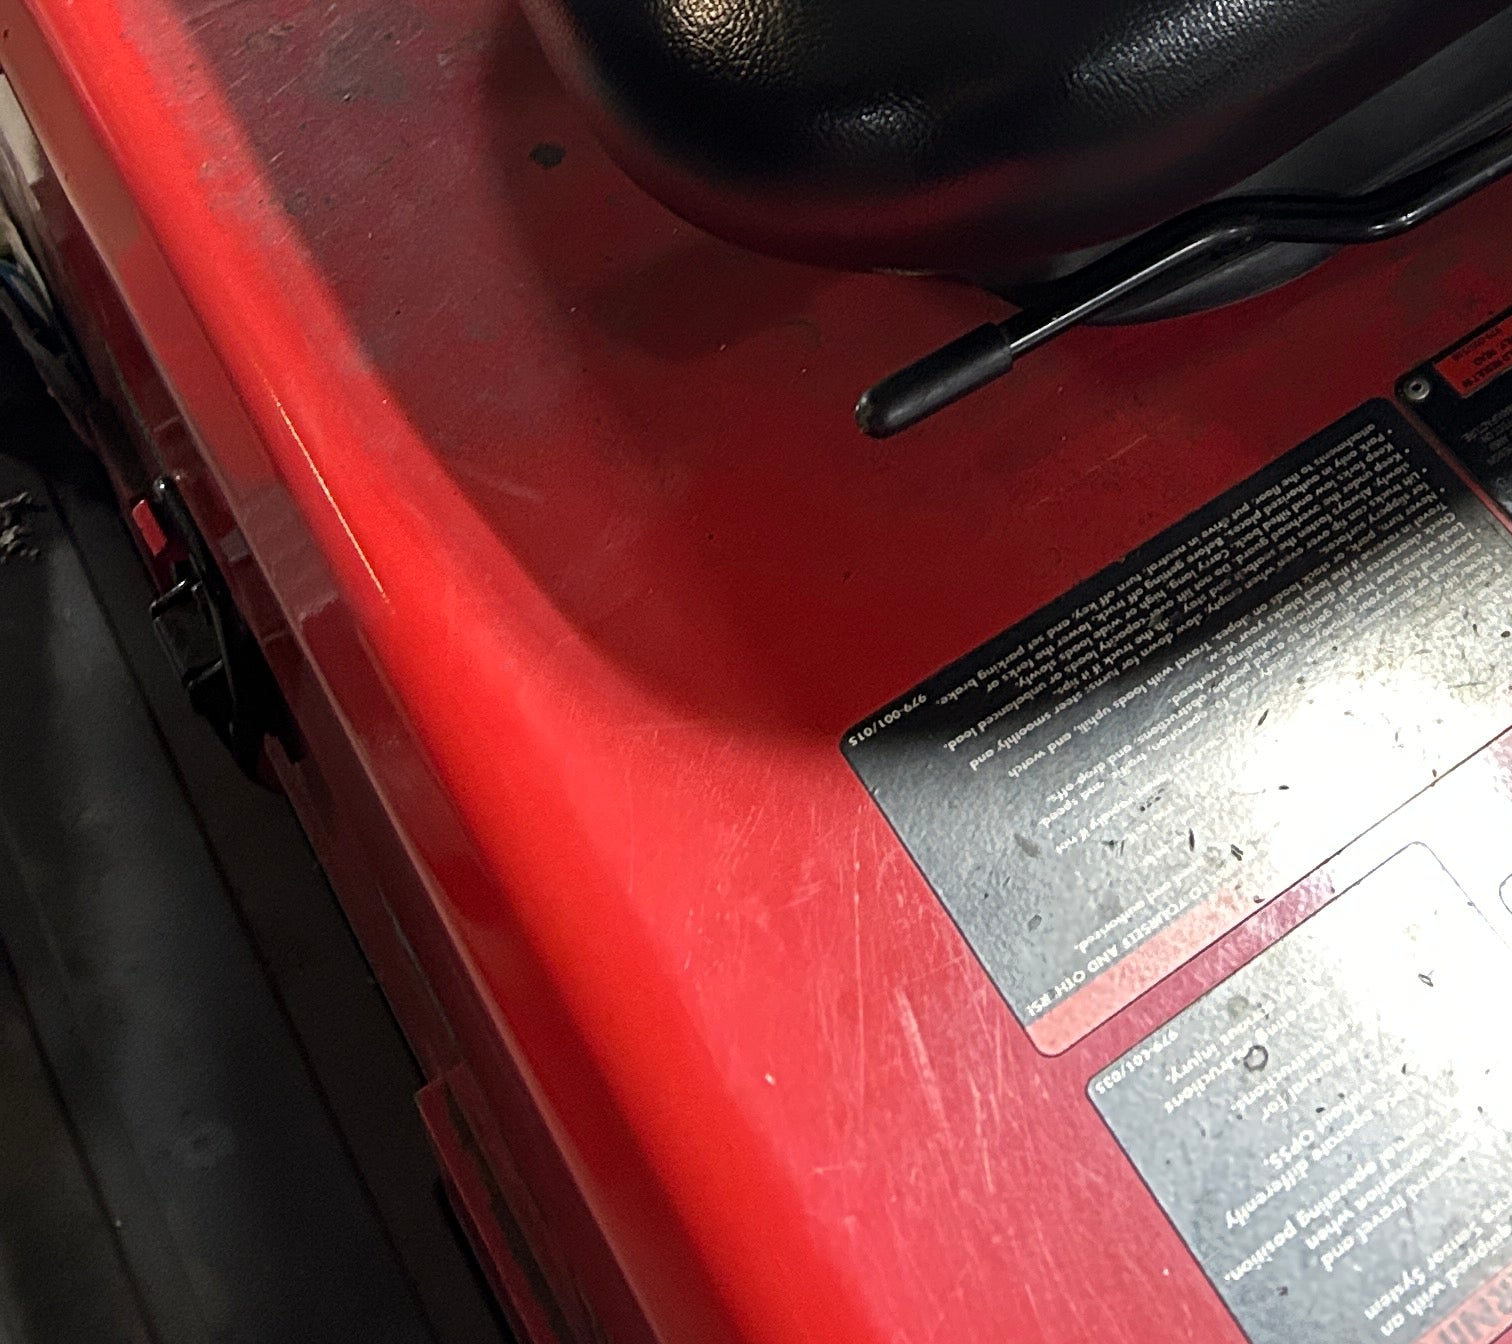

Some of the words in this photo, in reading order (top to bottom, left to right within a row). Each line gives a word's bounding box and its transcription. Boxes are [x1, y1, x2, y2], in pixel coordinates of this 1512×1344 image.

[1361, 438, 1396, 465] Keep
[1335, 459, 1366, 483] forks
[1312, 478, 1337, 498] low
[1289, 492, 1315, 513] and
[1260, 507, 1293, 532] tilted
[1422, 509, 1458, 536] Check
[1229, 526, 1264, 552] back.
[1194, 545, 1231, 574] Carry
[1365, 531, 1424, 575] clearances
[1164, 566, 1198, 594] long,
[1336, 578, 1355, 594] all
[1352, 569, 1368, 584] in
[1136, 586, 1168, 612] high
[1278, 587, 1338, 632] directions,
[1122, 606, 1138, 620] or
[1091, 616, 1125, 642] wide
[1058, 636, 1094, 664] loads
[1224, 625, 1281, 668] including
[1012, 656, 1059, 693] slowly.
[1165, 662, 1228, 709] overhead.
[845, 689, 929, 748] 979-001/015
